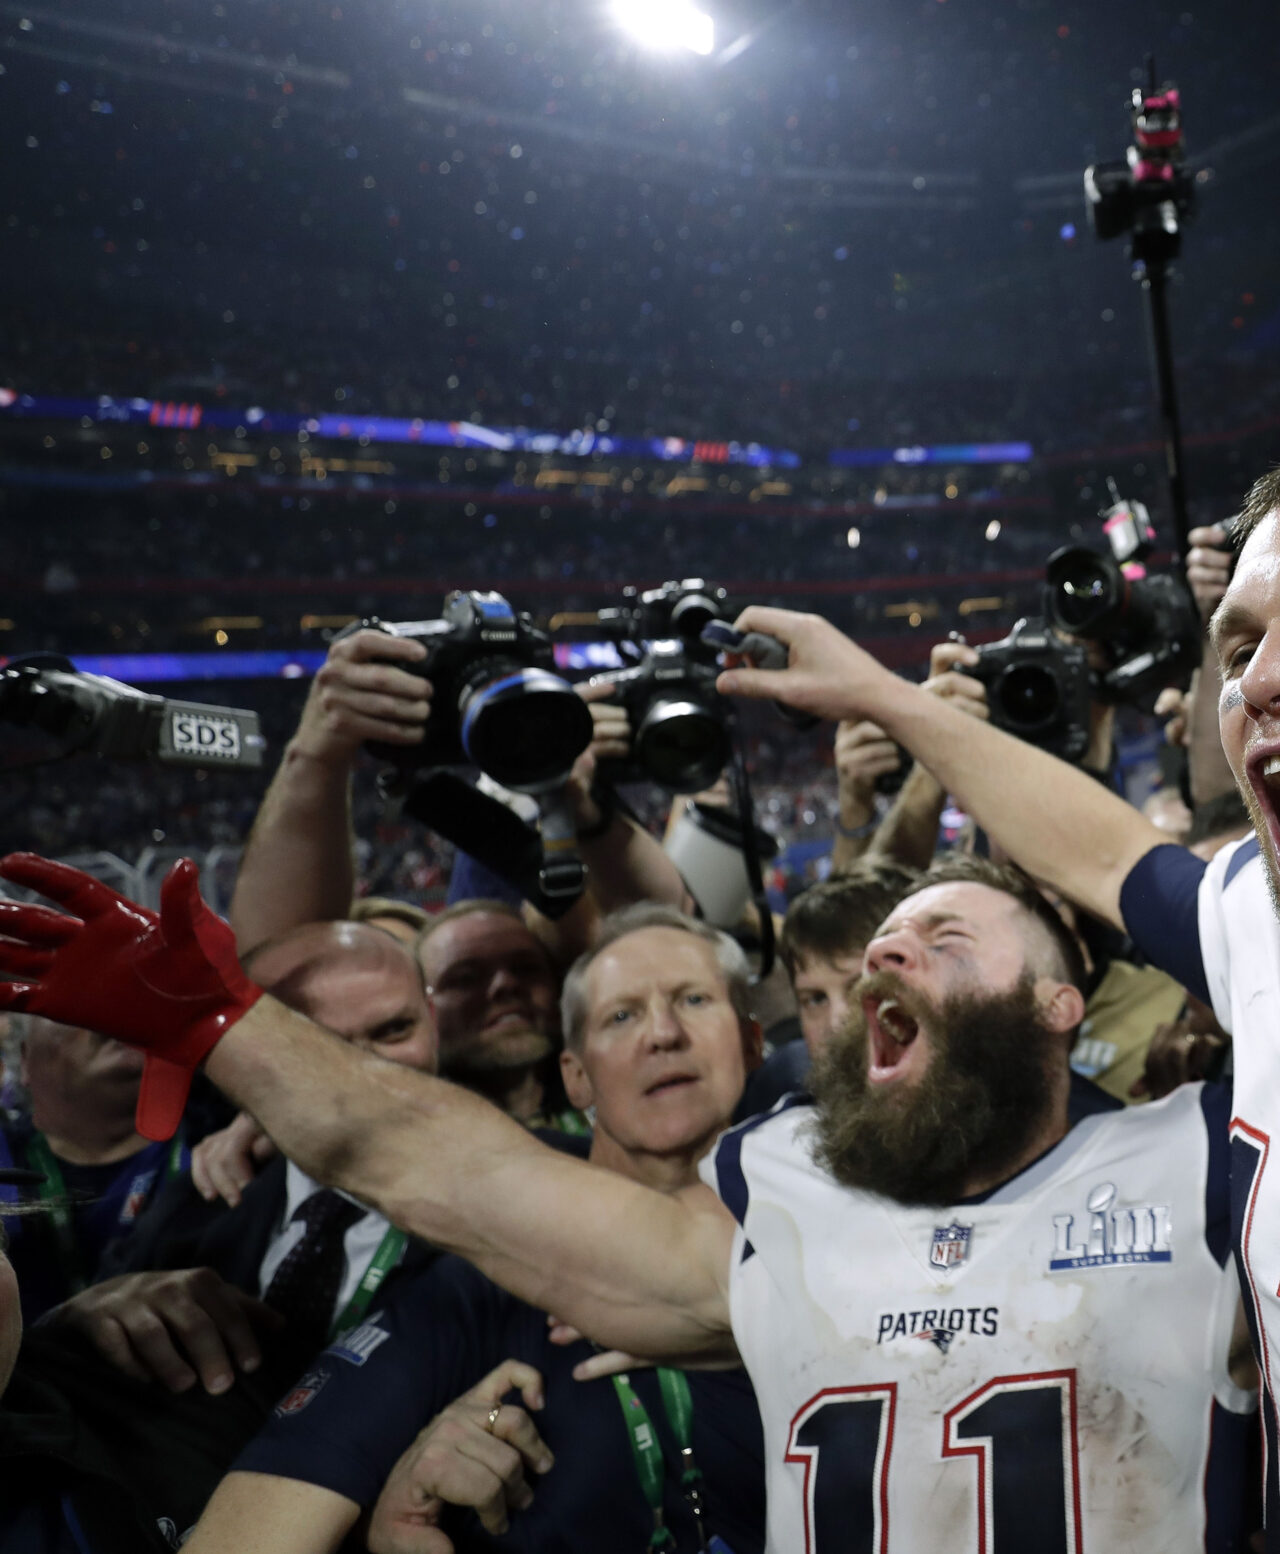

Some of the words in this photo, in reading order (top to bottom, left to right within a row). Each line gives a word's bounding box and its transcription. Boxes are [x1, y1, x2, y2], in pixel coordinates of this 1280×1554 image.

[177, 721, 235, 748] SDS
[934, 1241, 965, 1264] NFL
[1071, 1256, 1113, 1267] SUPER
[876, 1306, 999, 1346] PATRIOTS
[783, 1367, 1084, 1554] 11
